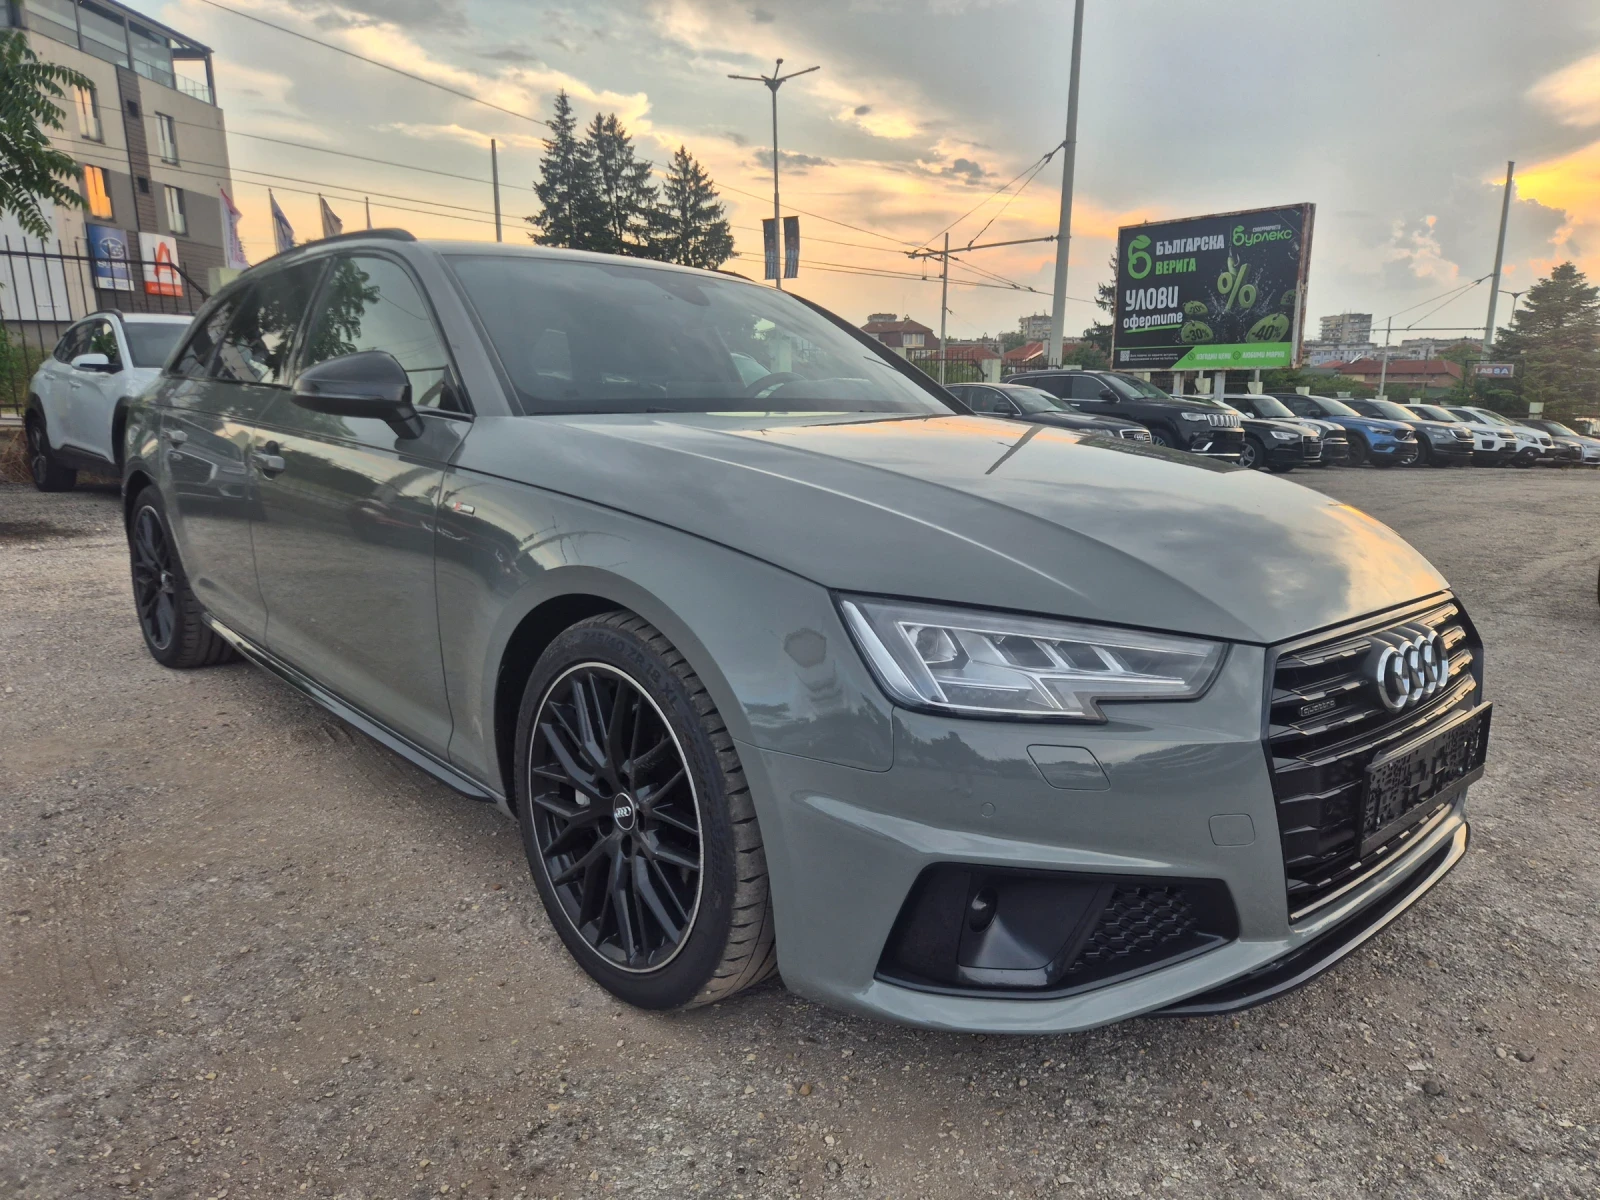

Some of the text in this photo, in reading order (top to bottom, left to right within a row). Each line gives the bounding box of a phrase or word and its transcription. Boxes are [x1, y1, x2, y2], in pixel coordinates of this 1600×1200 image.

[1155, 234, 1225, 256] БЪЛГАРСКА
[1155, 257, 1197, 275] ВЕРИГА
[1125, 286, 1179, 311] УЛОВИ
[1123, 311, 1183, 330] офертите
[1186, 328, 1210, 341] -30%
[1252, 325, 1282, 341] -40%
